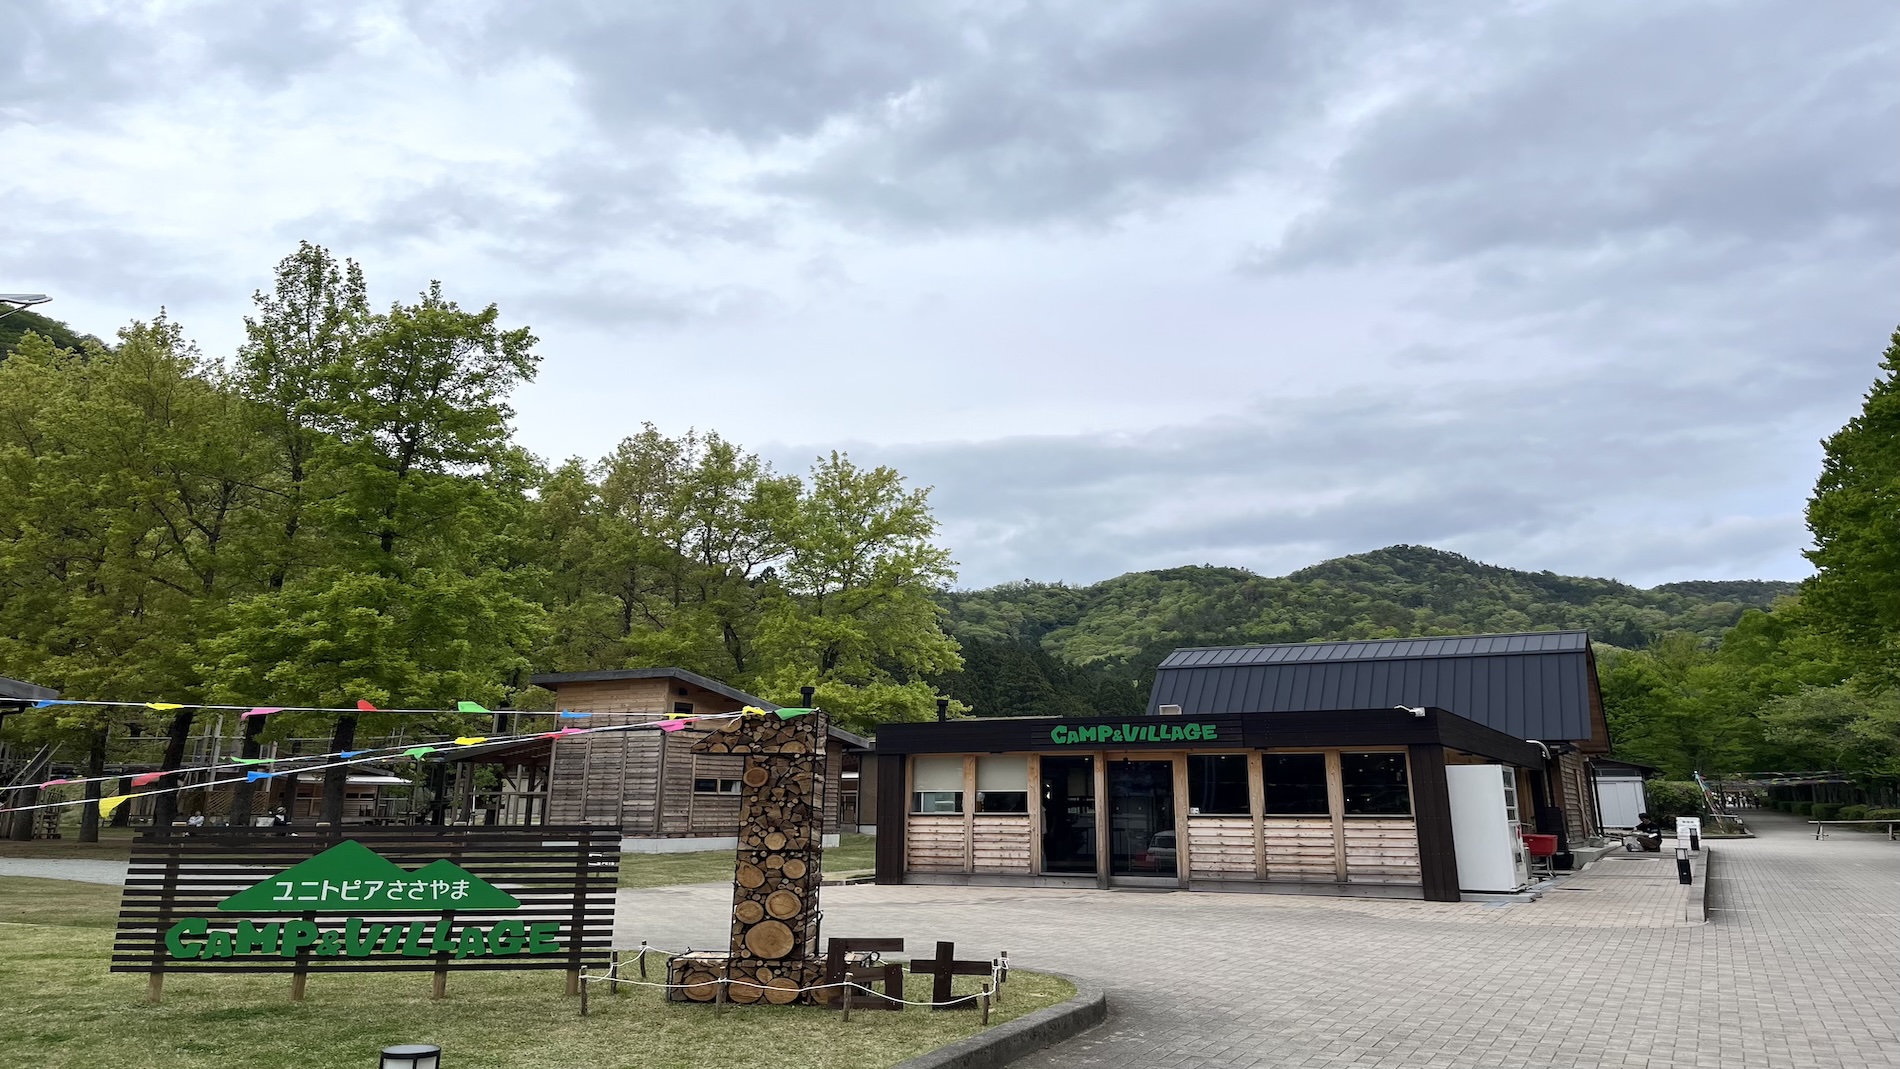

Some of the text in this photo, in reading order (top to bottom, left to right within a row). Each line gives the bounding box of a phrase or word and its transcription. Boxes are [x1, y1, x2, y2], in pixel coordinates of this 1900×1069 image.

[272, 879, 470, 901] ユニトピアささやま
